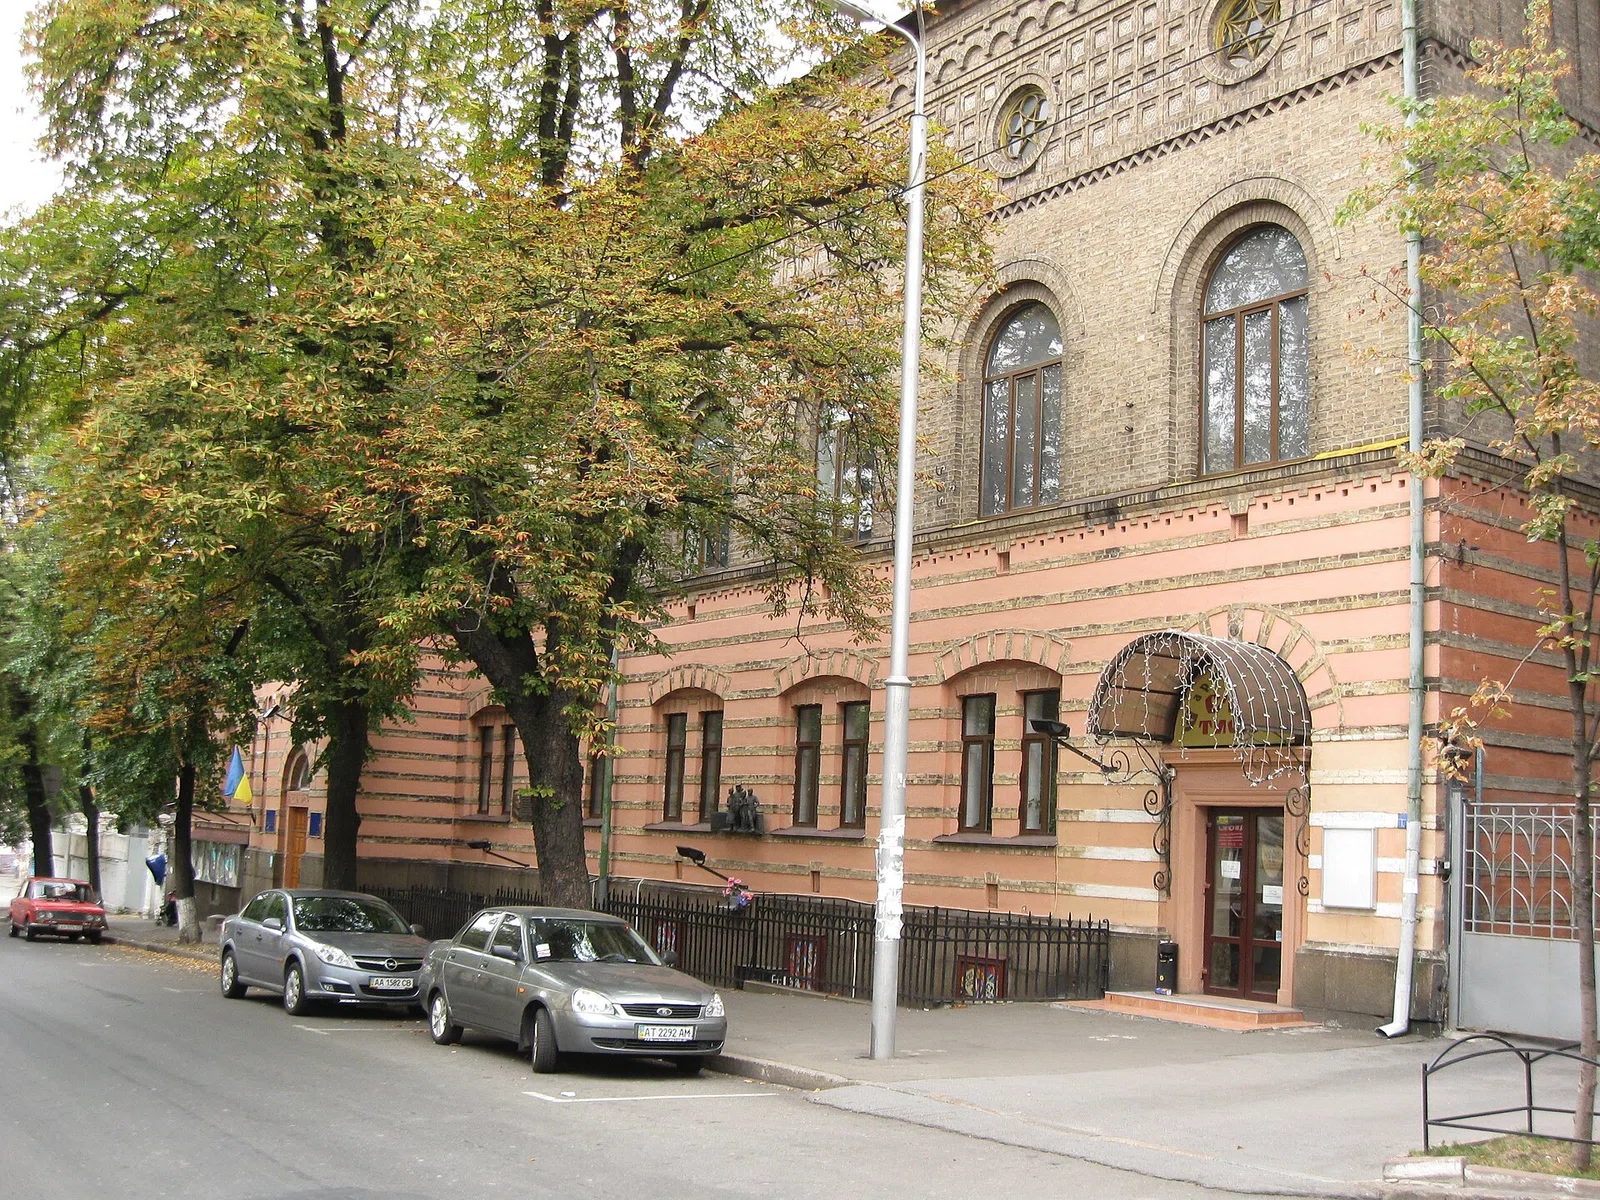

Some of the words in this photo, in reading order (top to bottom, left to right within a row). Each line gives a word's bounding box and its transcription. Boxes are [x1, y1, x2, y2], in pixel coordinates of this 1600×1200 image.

[374, 978, 385, 987] AA
[386, 979, 401, 988] 1582
[644, 1027, 656, 1037] AT
[658, 1028, 678, 1038] 2292
[679, 1028, 691, 1038] AM
